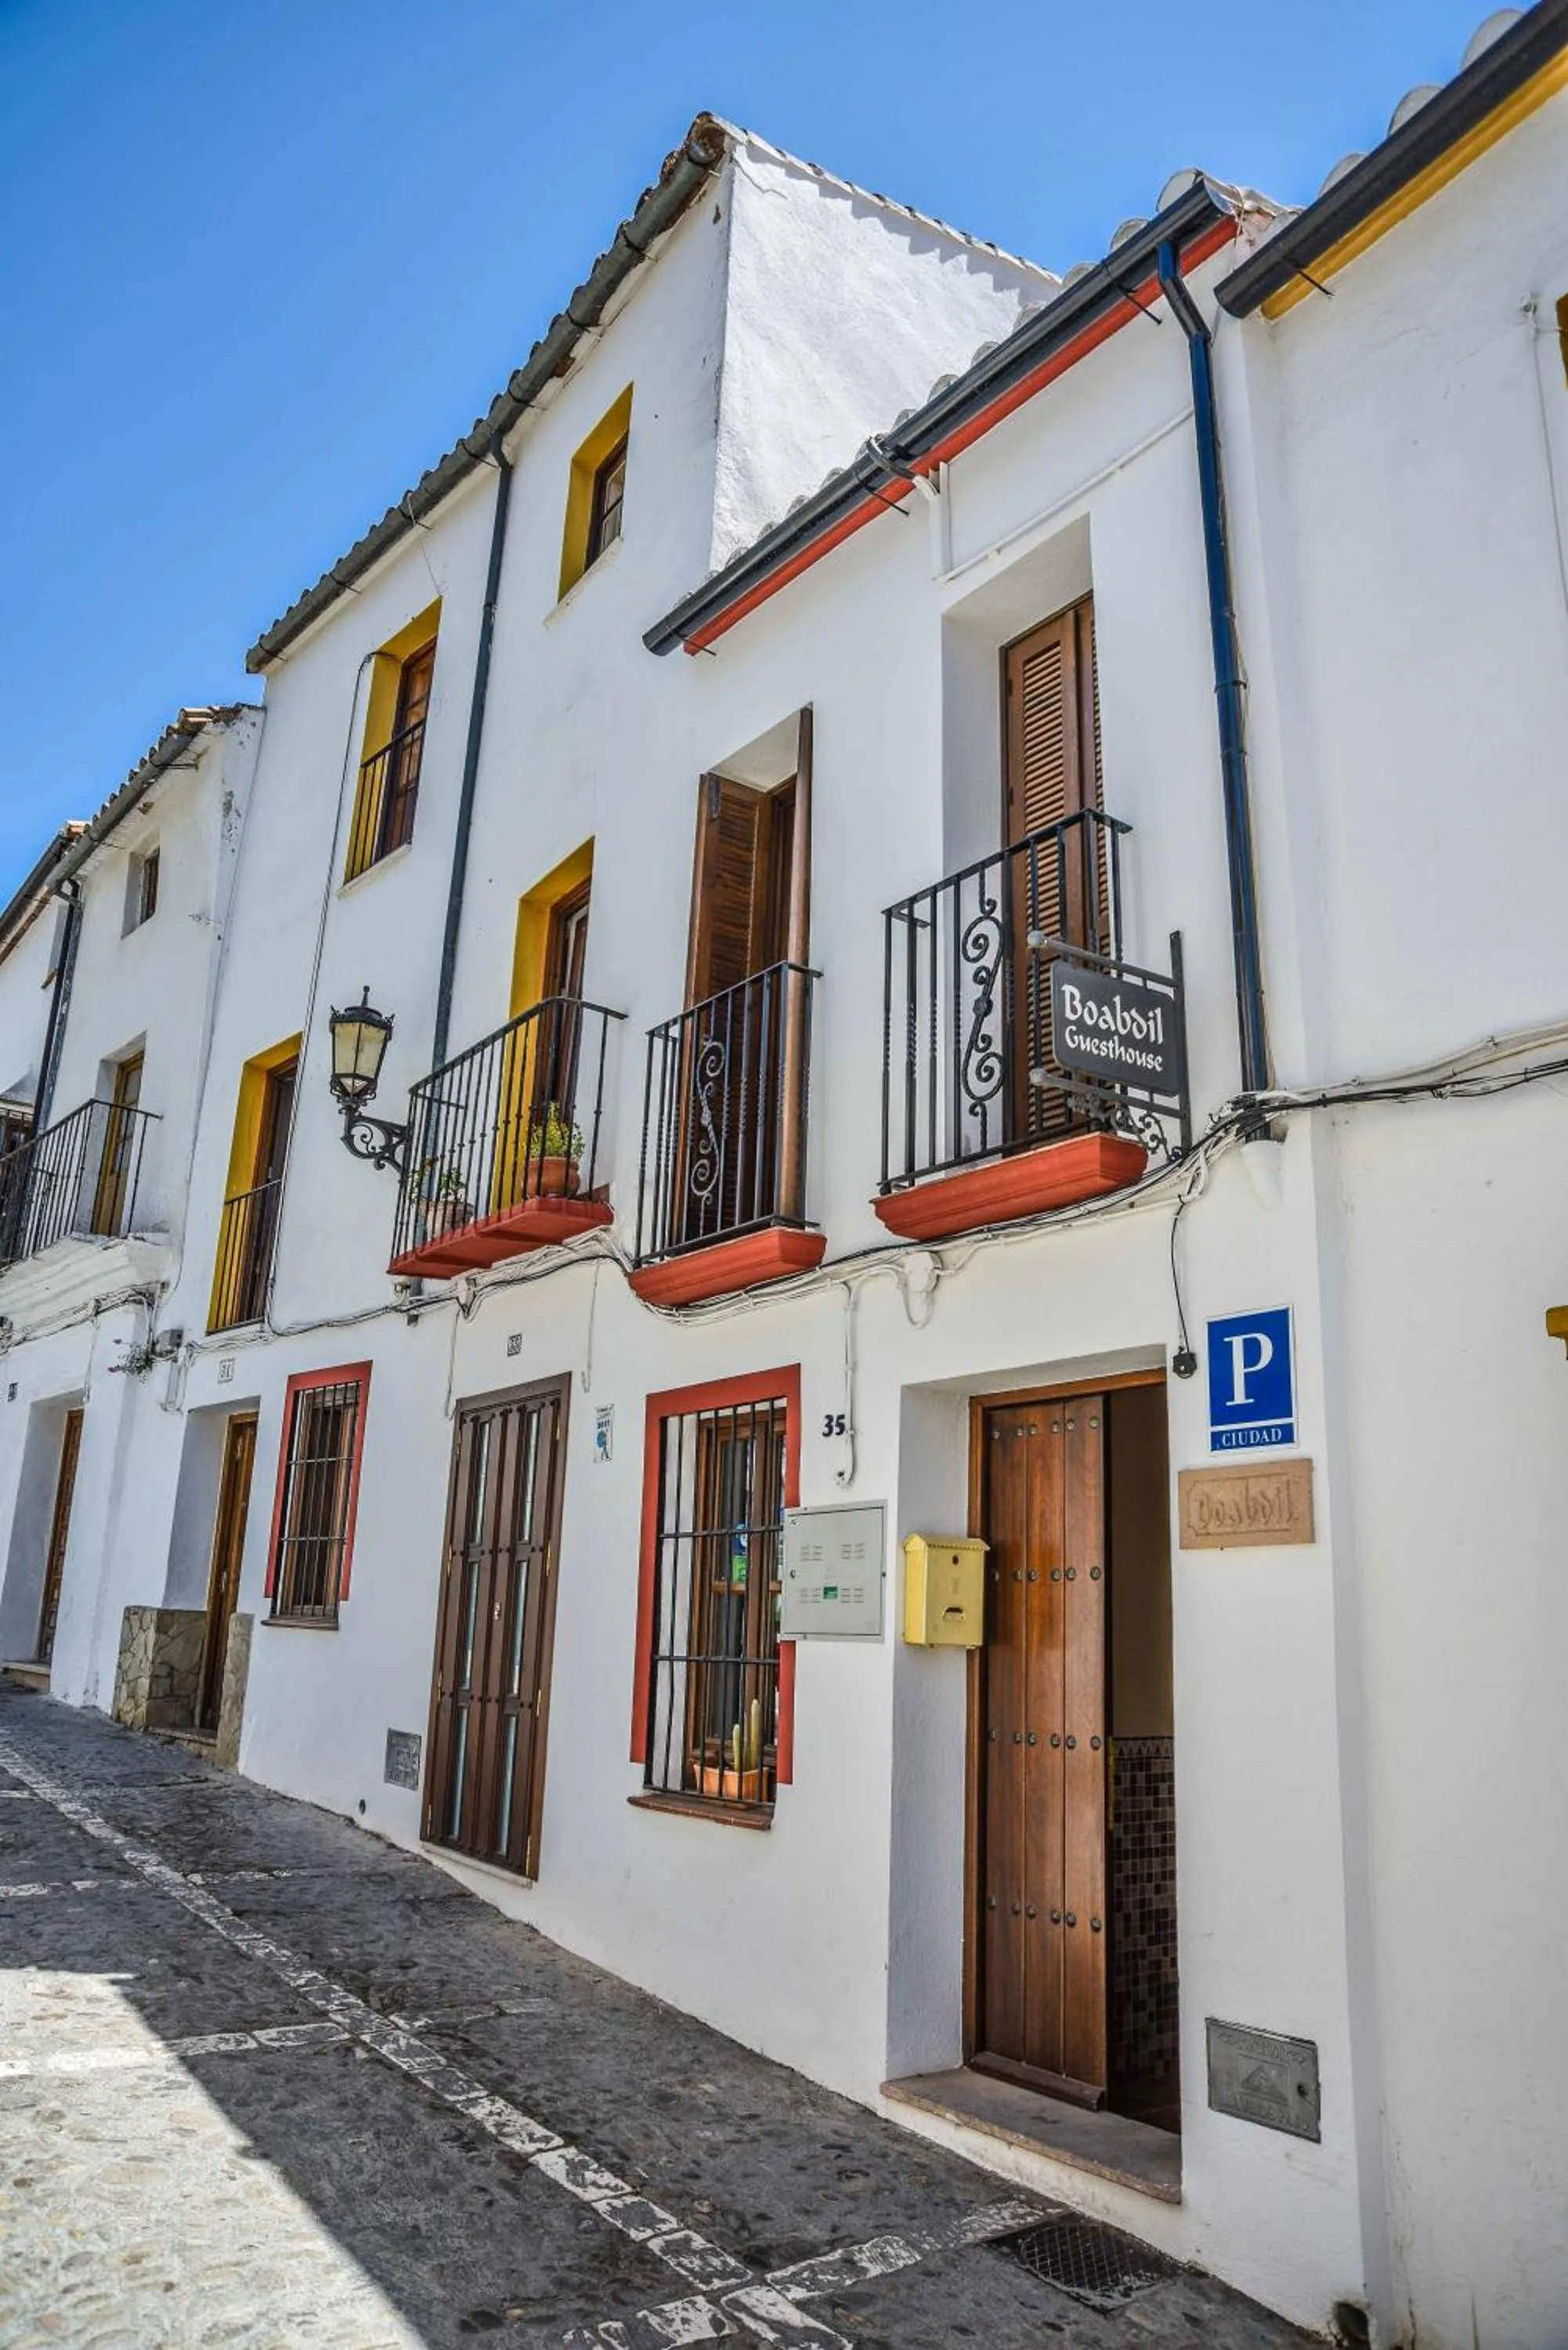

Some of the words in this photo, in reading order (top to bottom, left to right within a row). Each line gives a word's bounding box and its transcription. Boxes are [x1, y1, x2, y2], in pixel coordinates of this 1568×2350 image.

[1061, 984, 1164, 1044] Boabdil
[1065, 1025, 1163, 1072] Guesthouse
[1223, 1332, 1274, 1406] P
[822, 1413, 846, 1437] 35
[1222, 1427, 1282, 1447] CIUDAD
